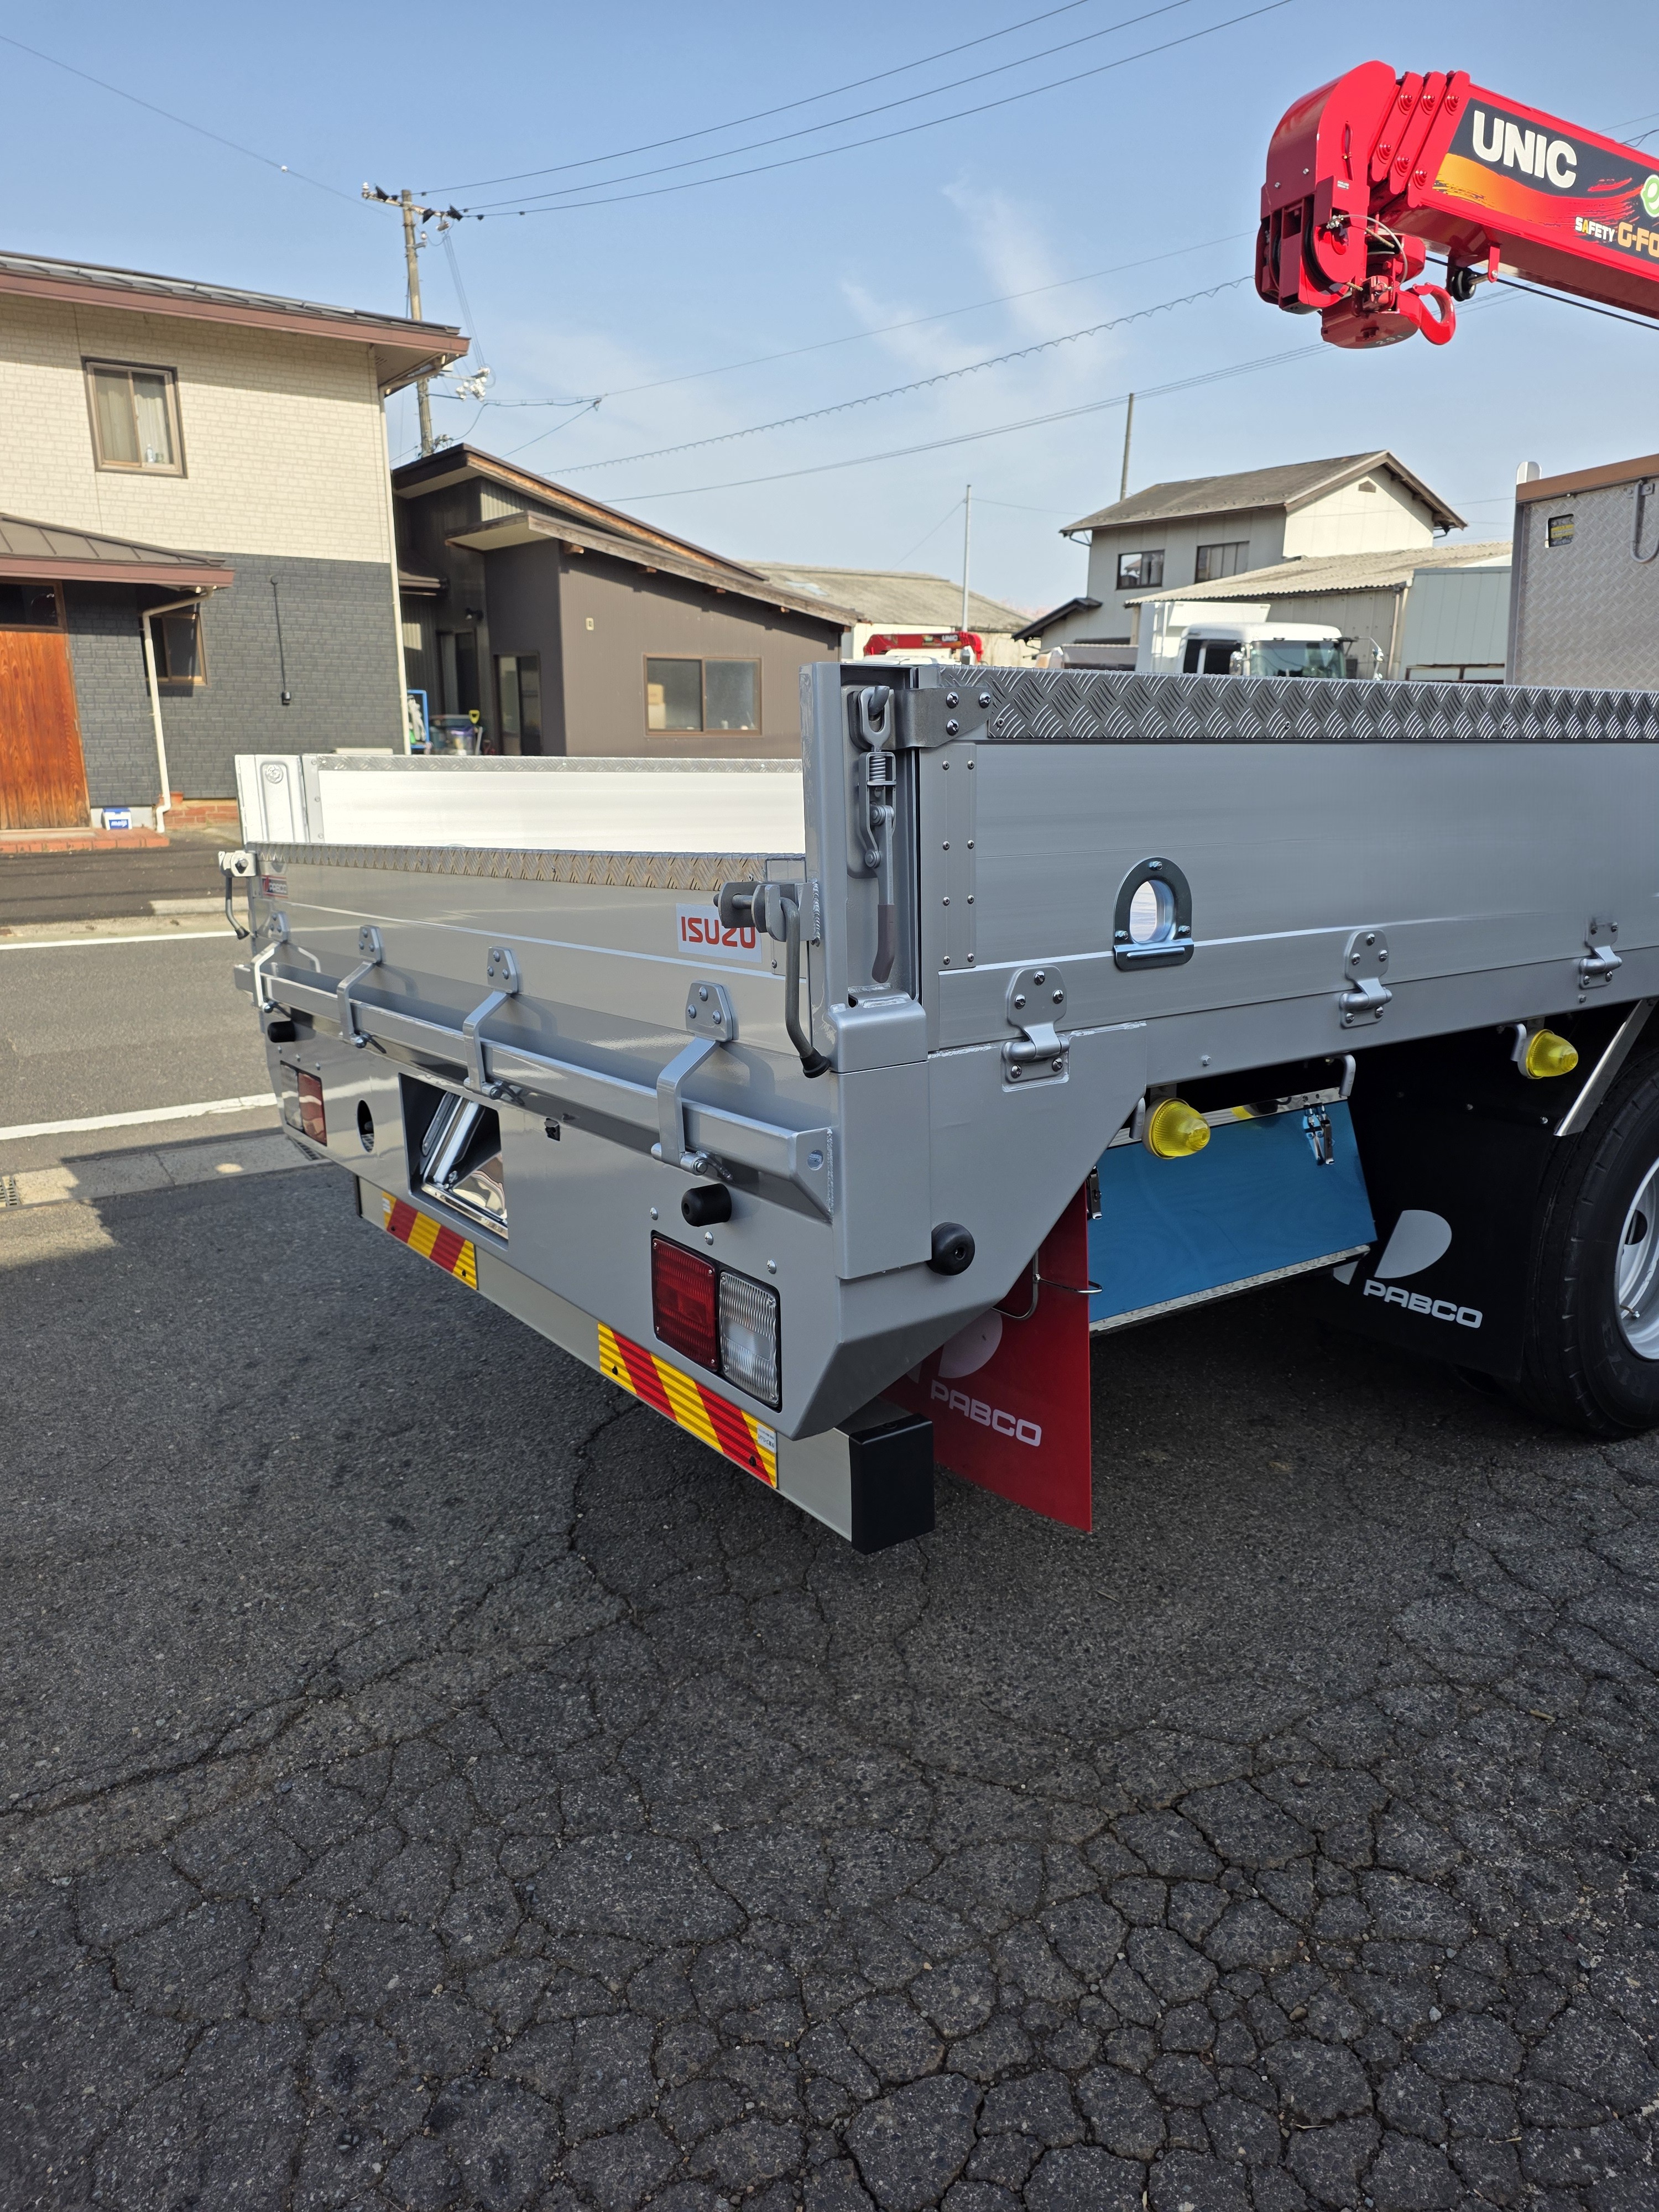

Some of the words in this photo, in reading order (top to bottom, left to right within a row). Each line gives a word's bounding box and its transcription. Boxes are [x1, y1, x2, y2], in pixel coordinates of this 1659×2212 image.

[1473, 110, 1577, 188] UNIC
[1575, 216, 1615, 242] SAFETY
[681, 916, 755, 949] ISUZU
[1363, 1279, 1483, 1328] PABCO
[931, 1379, 1042, 1447] PABCO
